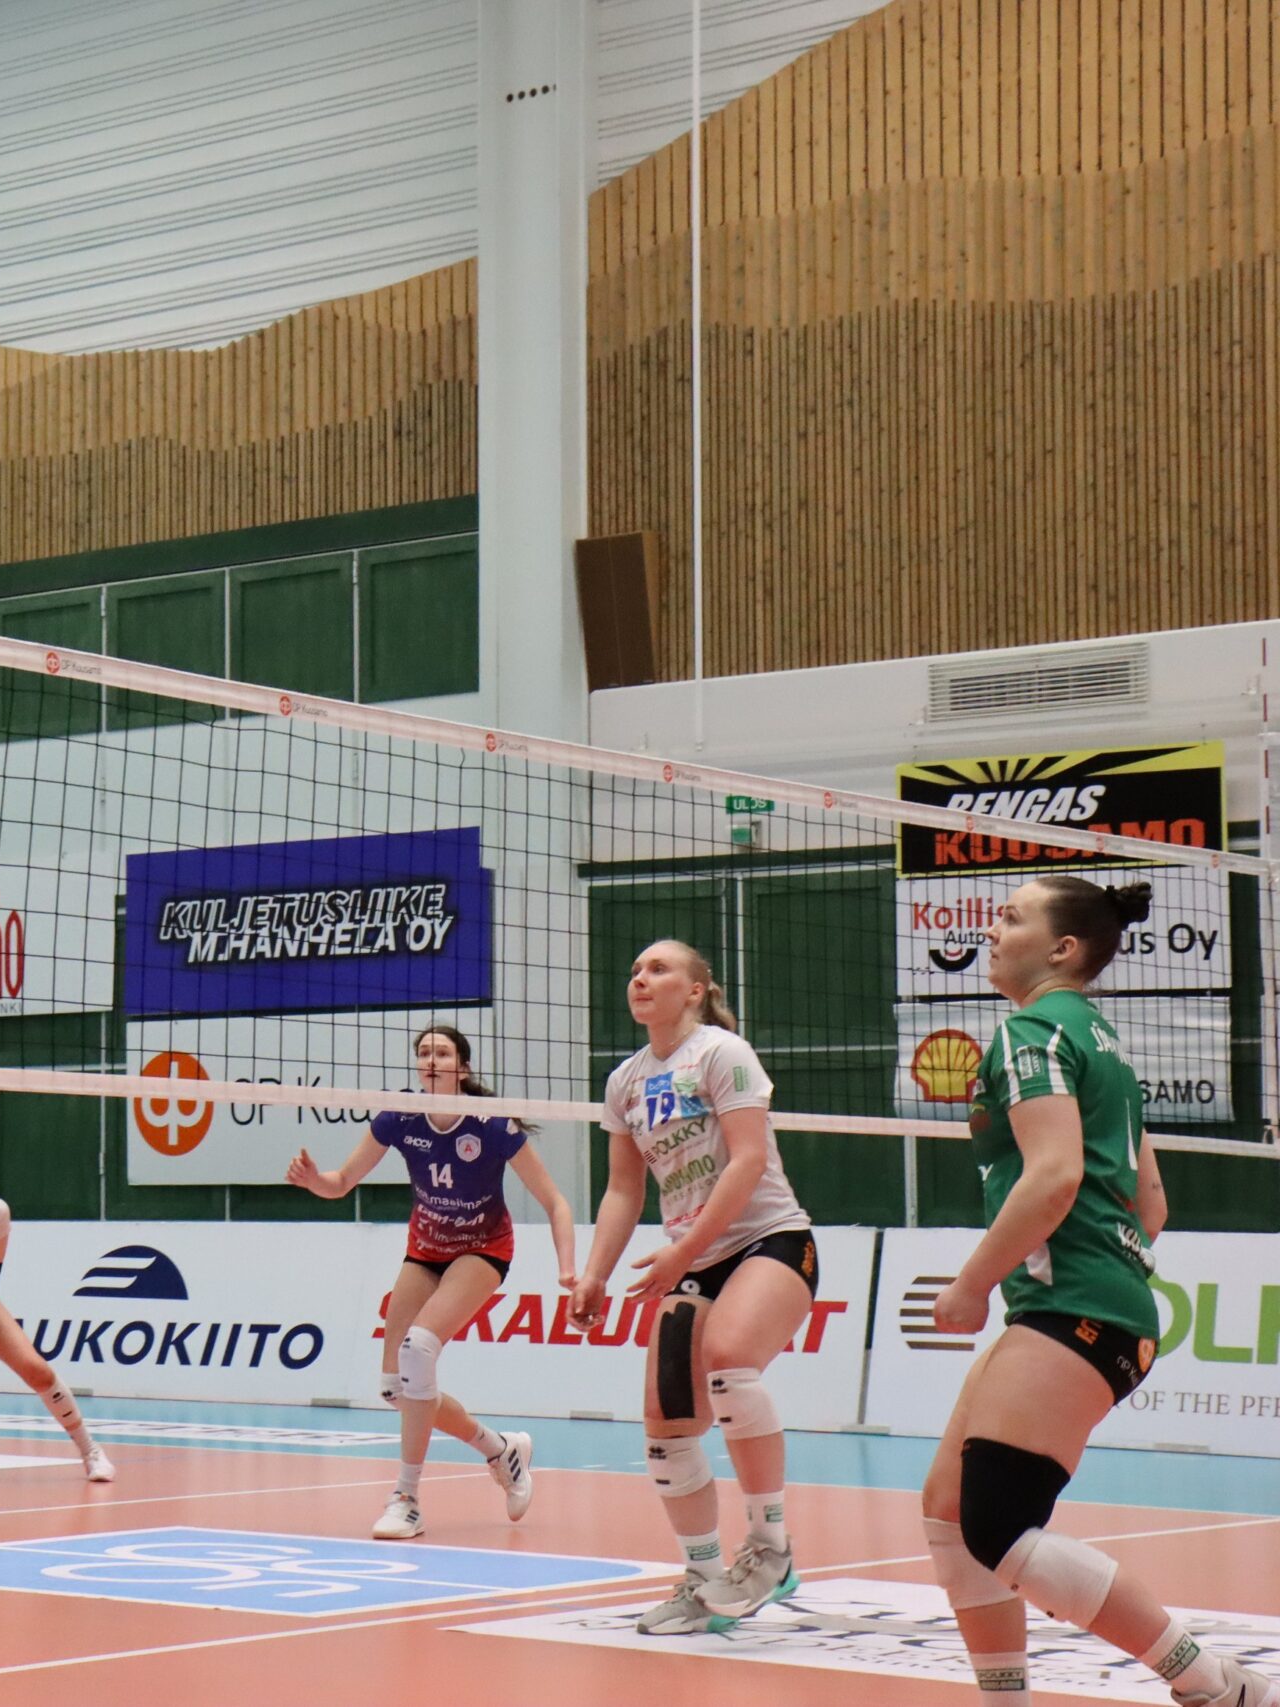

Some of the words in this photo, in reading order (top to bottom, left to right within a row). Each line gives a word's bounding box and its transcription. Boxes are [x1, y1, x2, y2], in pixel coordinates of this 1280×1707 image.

[733, 798, 768, 811] ULOS
[160, 884, 447, 940] KULJETUSLIIKE
[407, 916, 455, 951] OY
[1168, 923, 1219, 960] Oy
[646, 1092, 675, 1132] 19
[428, 1163, 454, 1189] 14
[1129, 1389, 1166, 1412] OF
[1174, 1391, 1231, 1416] THE
